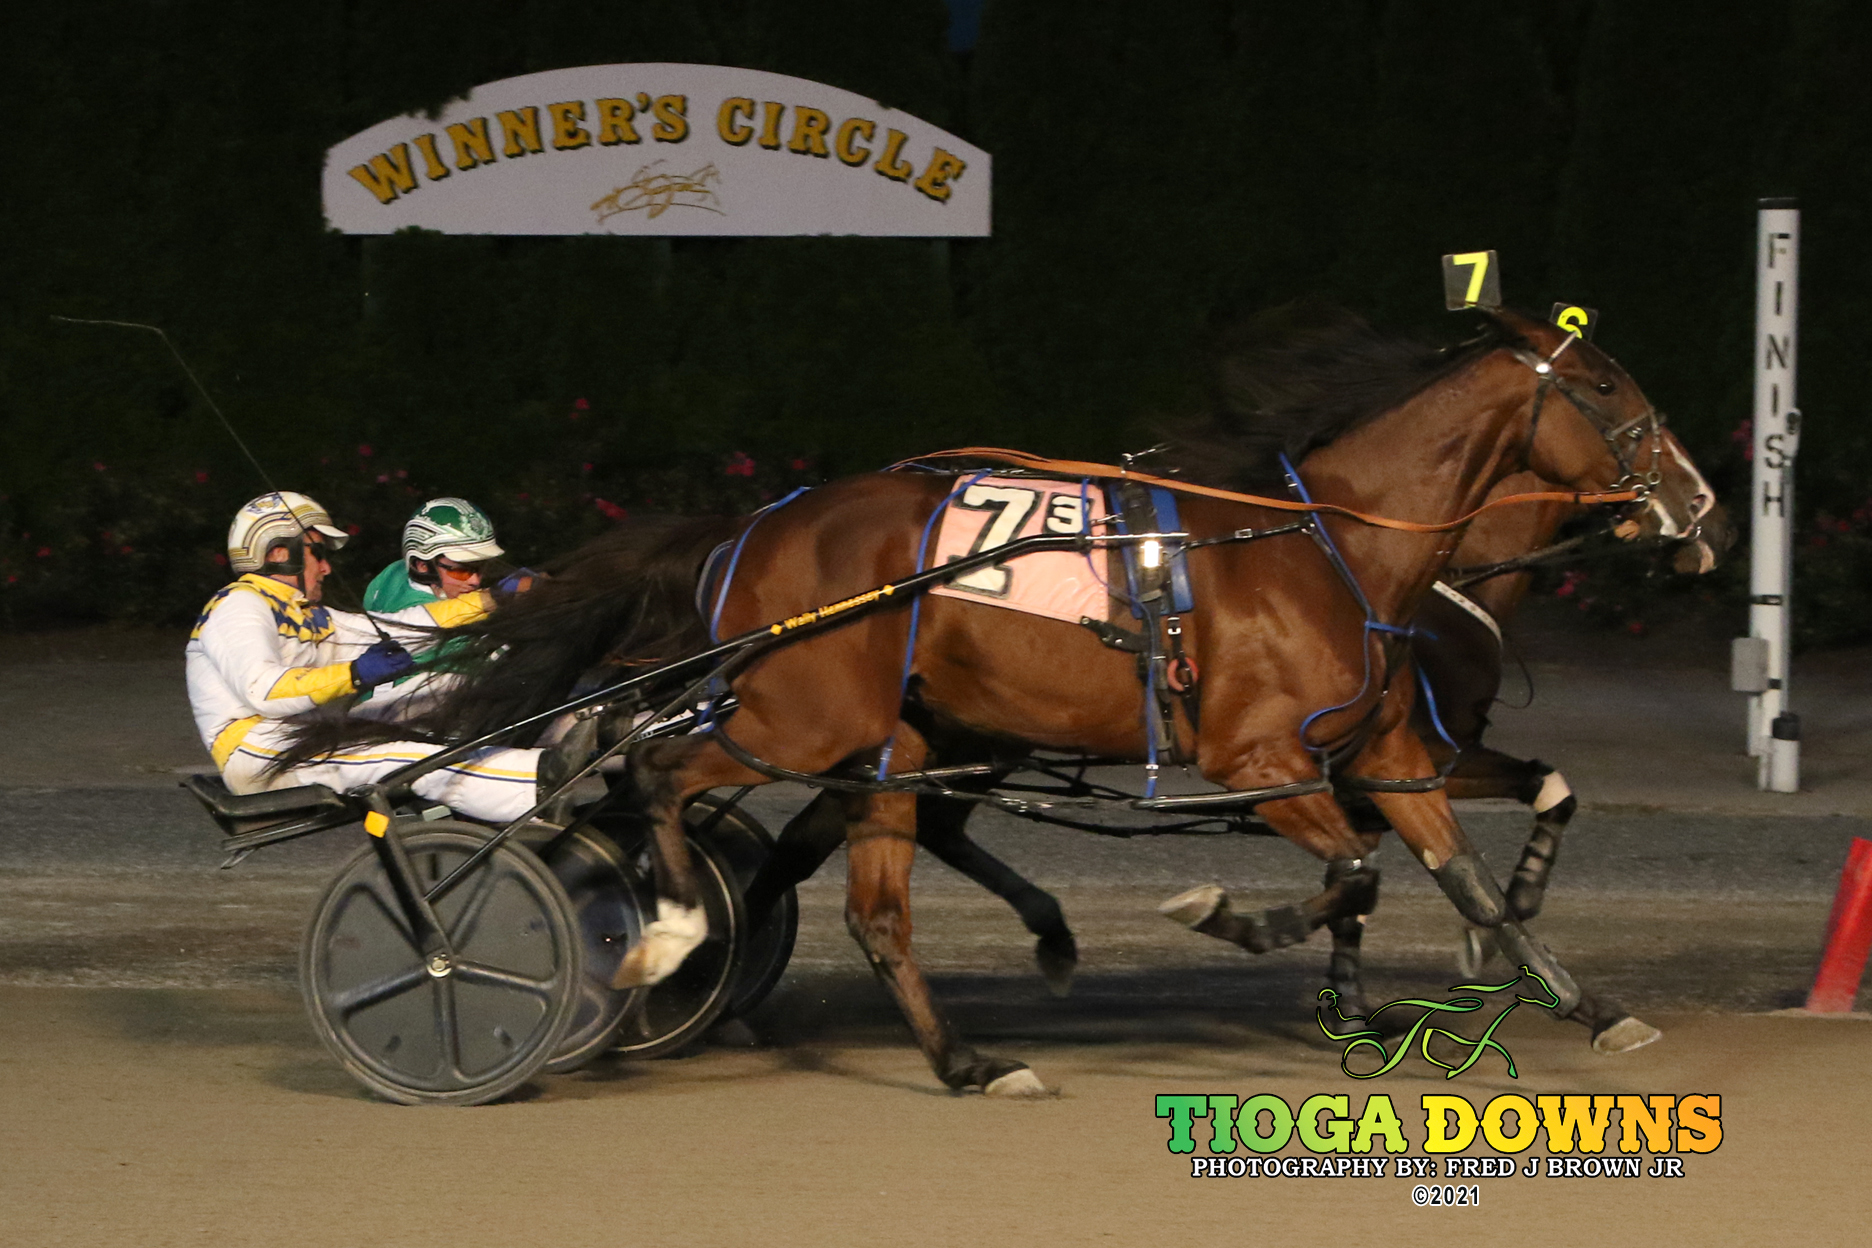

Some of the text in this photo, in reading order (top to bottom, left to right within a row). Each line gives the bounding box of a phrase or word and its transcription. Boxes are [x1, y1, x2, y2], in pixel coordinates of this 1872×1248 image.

[347, 92, 966, 205] WINNER'S CIRCLE
[1453, 251, 1489, 308] 7
[1762, 232, 1791, 518] FINISH
[951, 484, 1092, 600] 7 3
